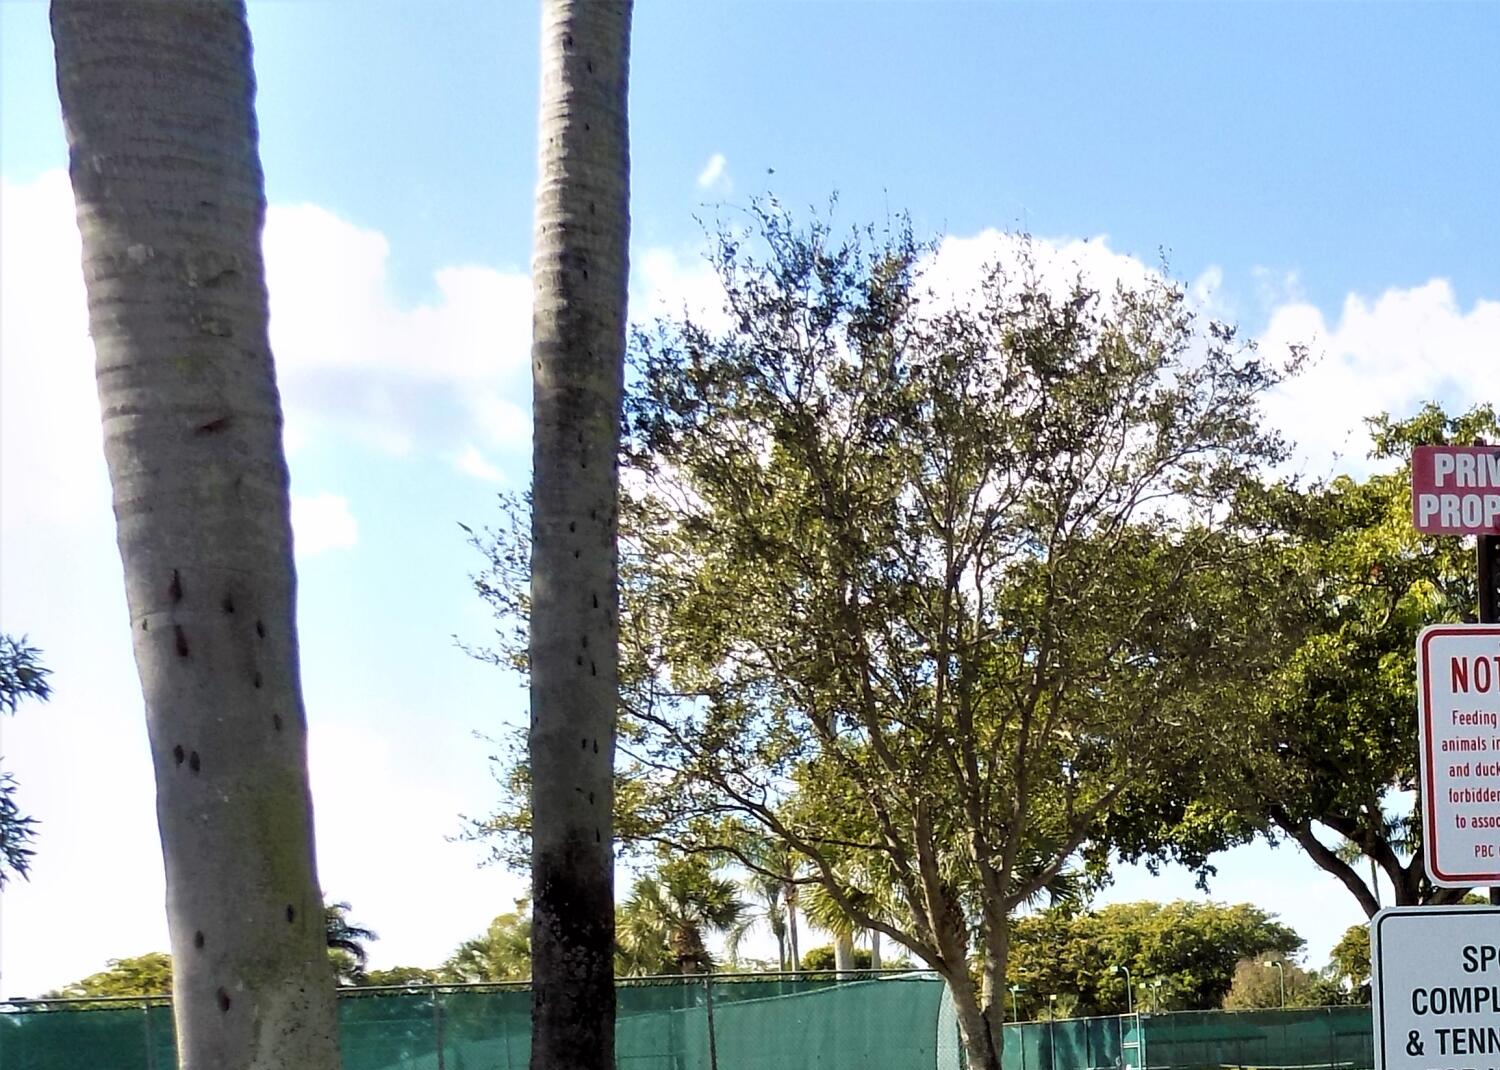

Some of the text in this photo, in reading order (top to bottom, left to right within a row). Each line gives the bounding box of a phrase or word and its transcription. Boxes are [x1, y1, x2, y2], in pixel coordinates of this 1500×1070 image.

[1452, 710, 1497, 728] Feeding
[1441, 736, 1487, 751] animals
[1449, 762, 1470, 777] and
[1456, 814, 1466, 829] to
[1475, 844, 1494, 858] PBC
[1406, 1030, 1424, 1056] &
